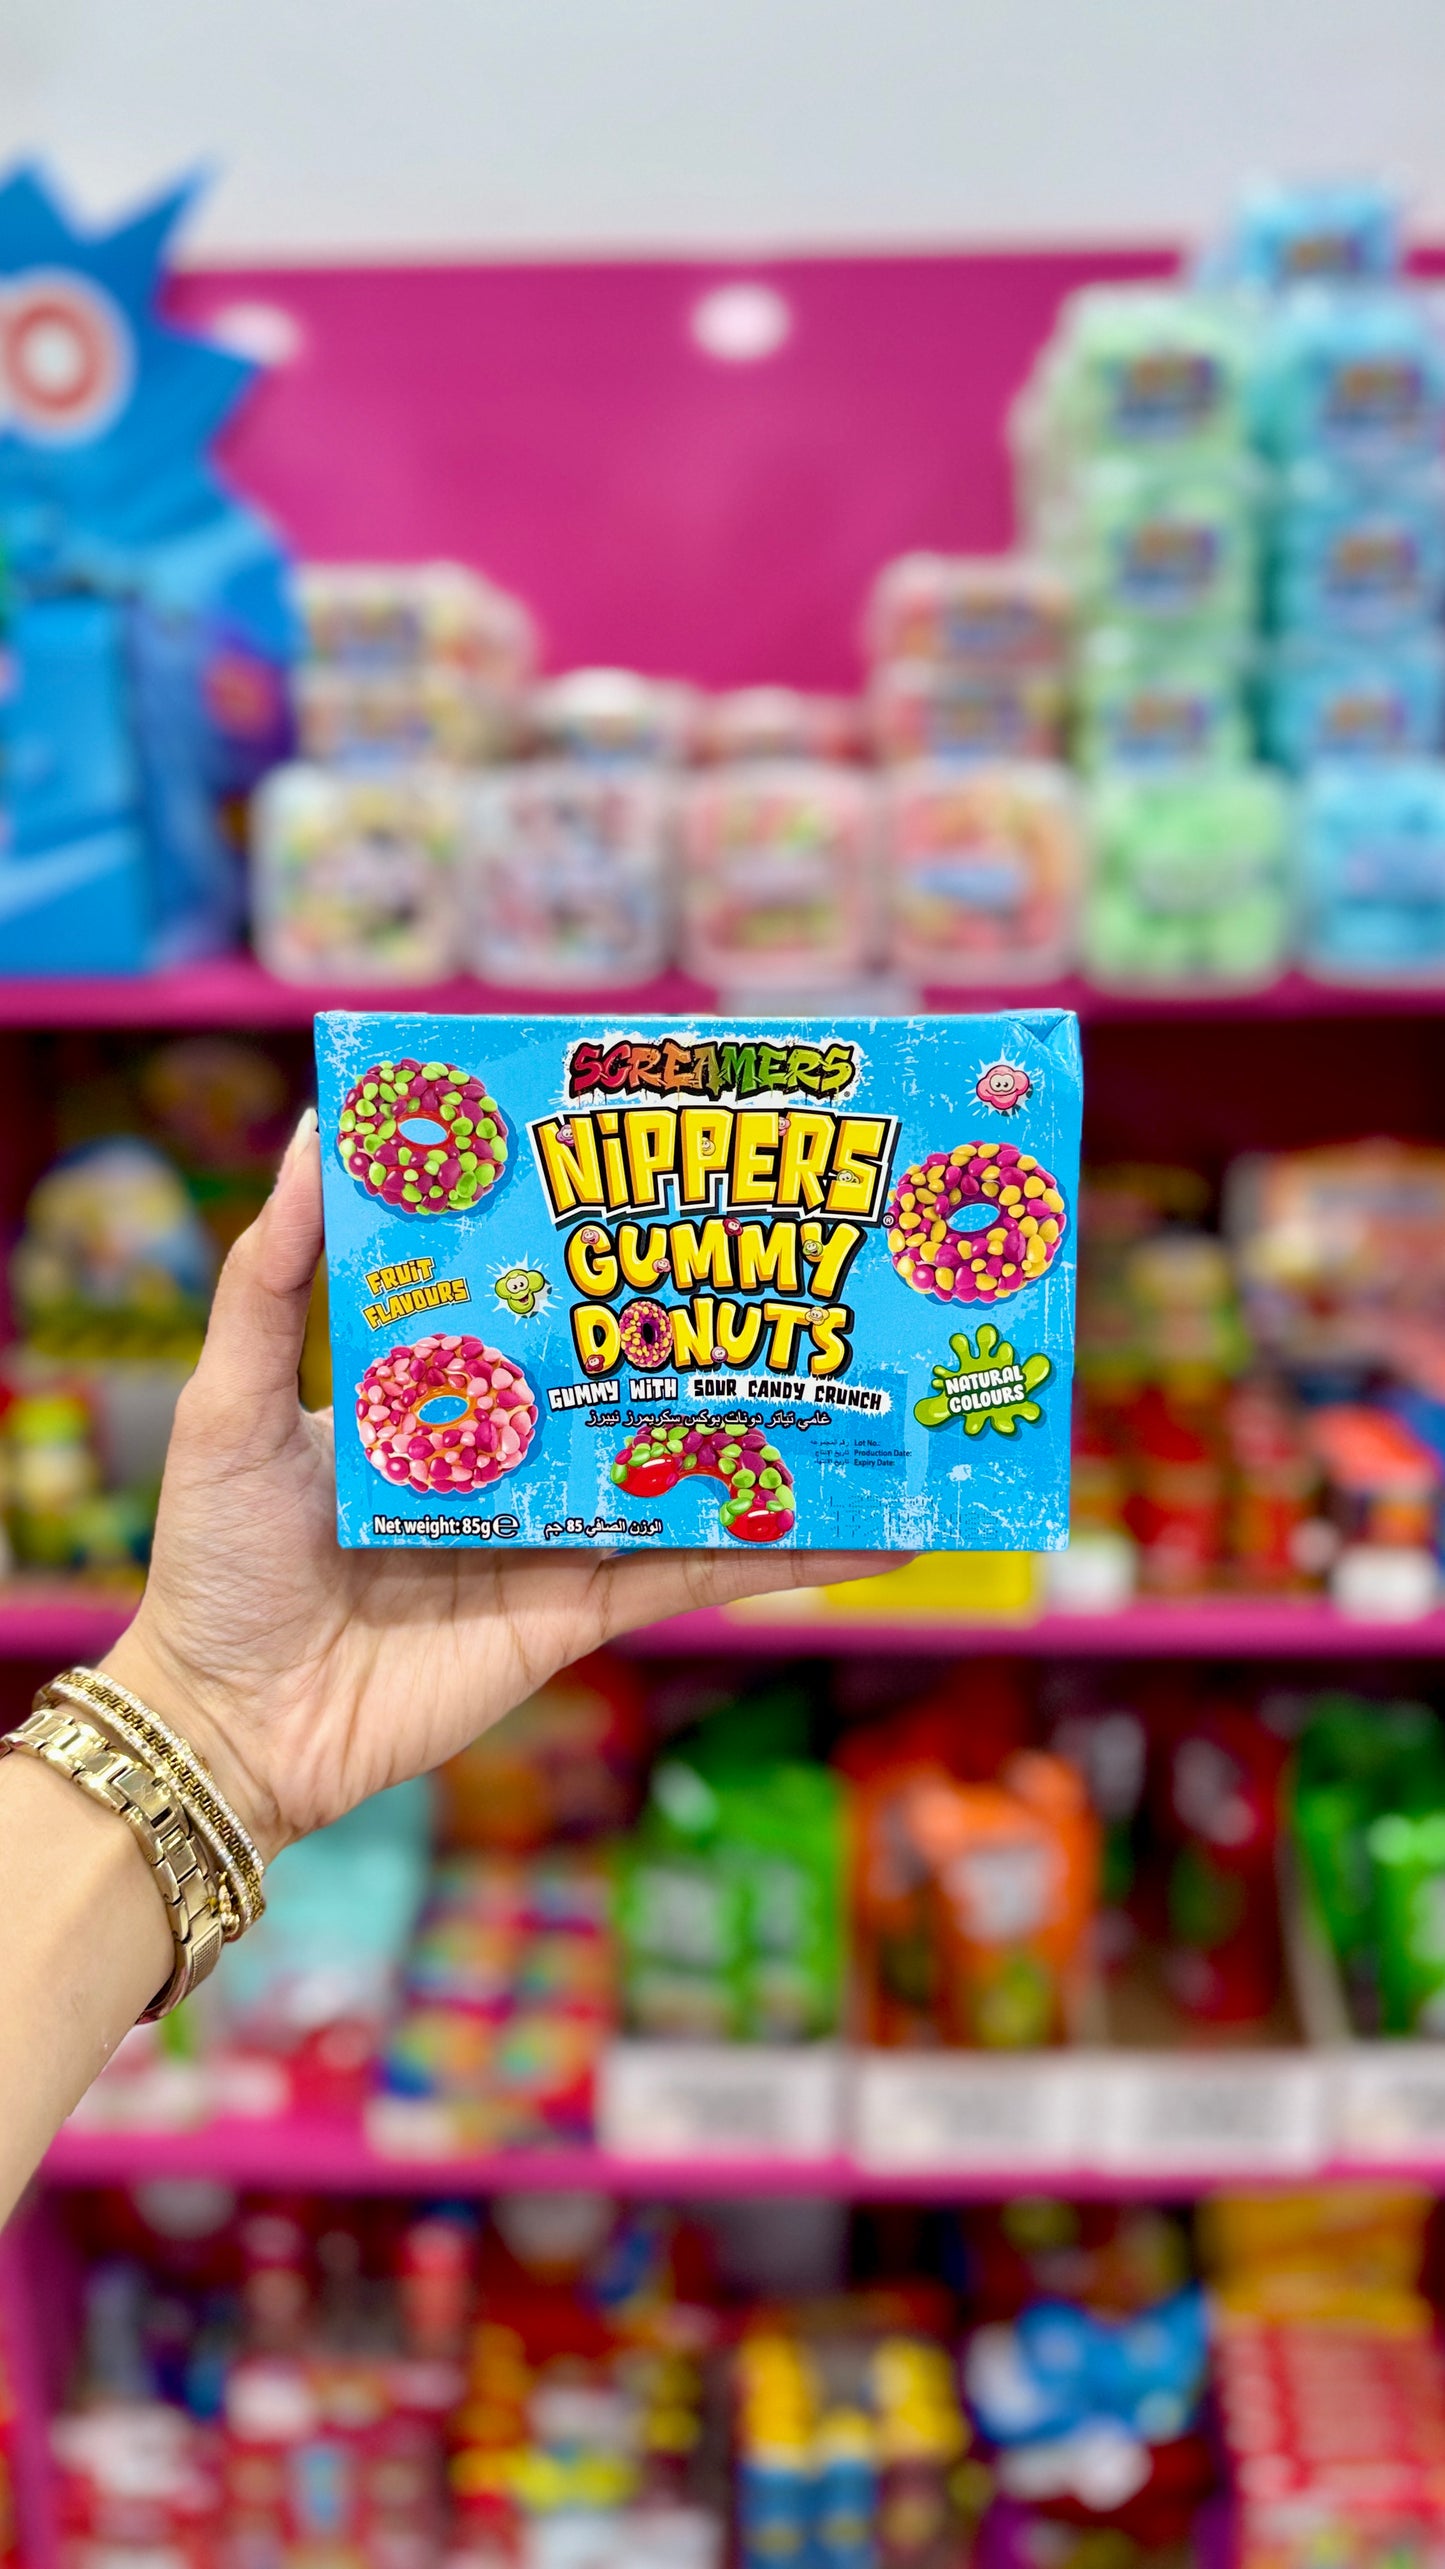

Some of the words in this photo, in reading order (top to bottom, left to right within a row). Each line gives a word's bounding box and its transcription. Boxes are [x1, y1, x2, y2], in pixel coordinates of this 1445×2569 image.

[569, 1040, 856, 1098] SCREAMERS
[568, 1219, 862, 1298] GUMMY
[361, 1277, 470, 1330] FLAVOURS
[573, 1298, 849, 1376] DONUTS
[944, 1364, 1024, 1396] NATURAL
[548, 1380, 619, 1410] GUMMY
[694, 1378, 737, 1397] SOUR
[749, 1380, 805, 1400] CANDY
[815, 1385, 882, 1411] CRUNCH
[949, 1383, 1025, 1414] COLOURS
[684, 1410, 721, 1427] بوكس
[854, 1450, 893, 1458] Production
[854, 1459, 875, 1468] Expiry
[877, 1459, 896, 1467] Date:
[374, 1515, 400, 1534] Net
[404, 1514, 460, 1539] weight:
[566, 1519, 583, 1533] 85
[585, 1518, 626, 1537] الصافي
[629, 1520, 662, 1535] الوزن
